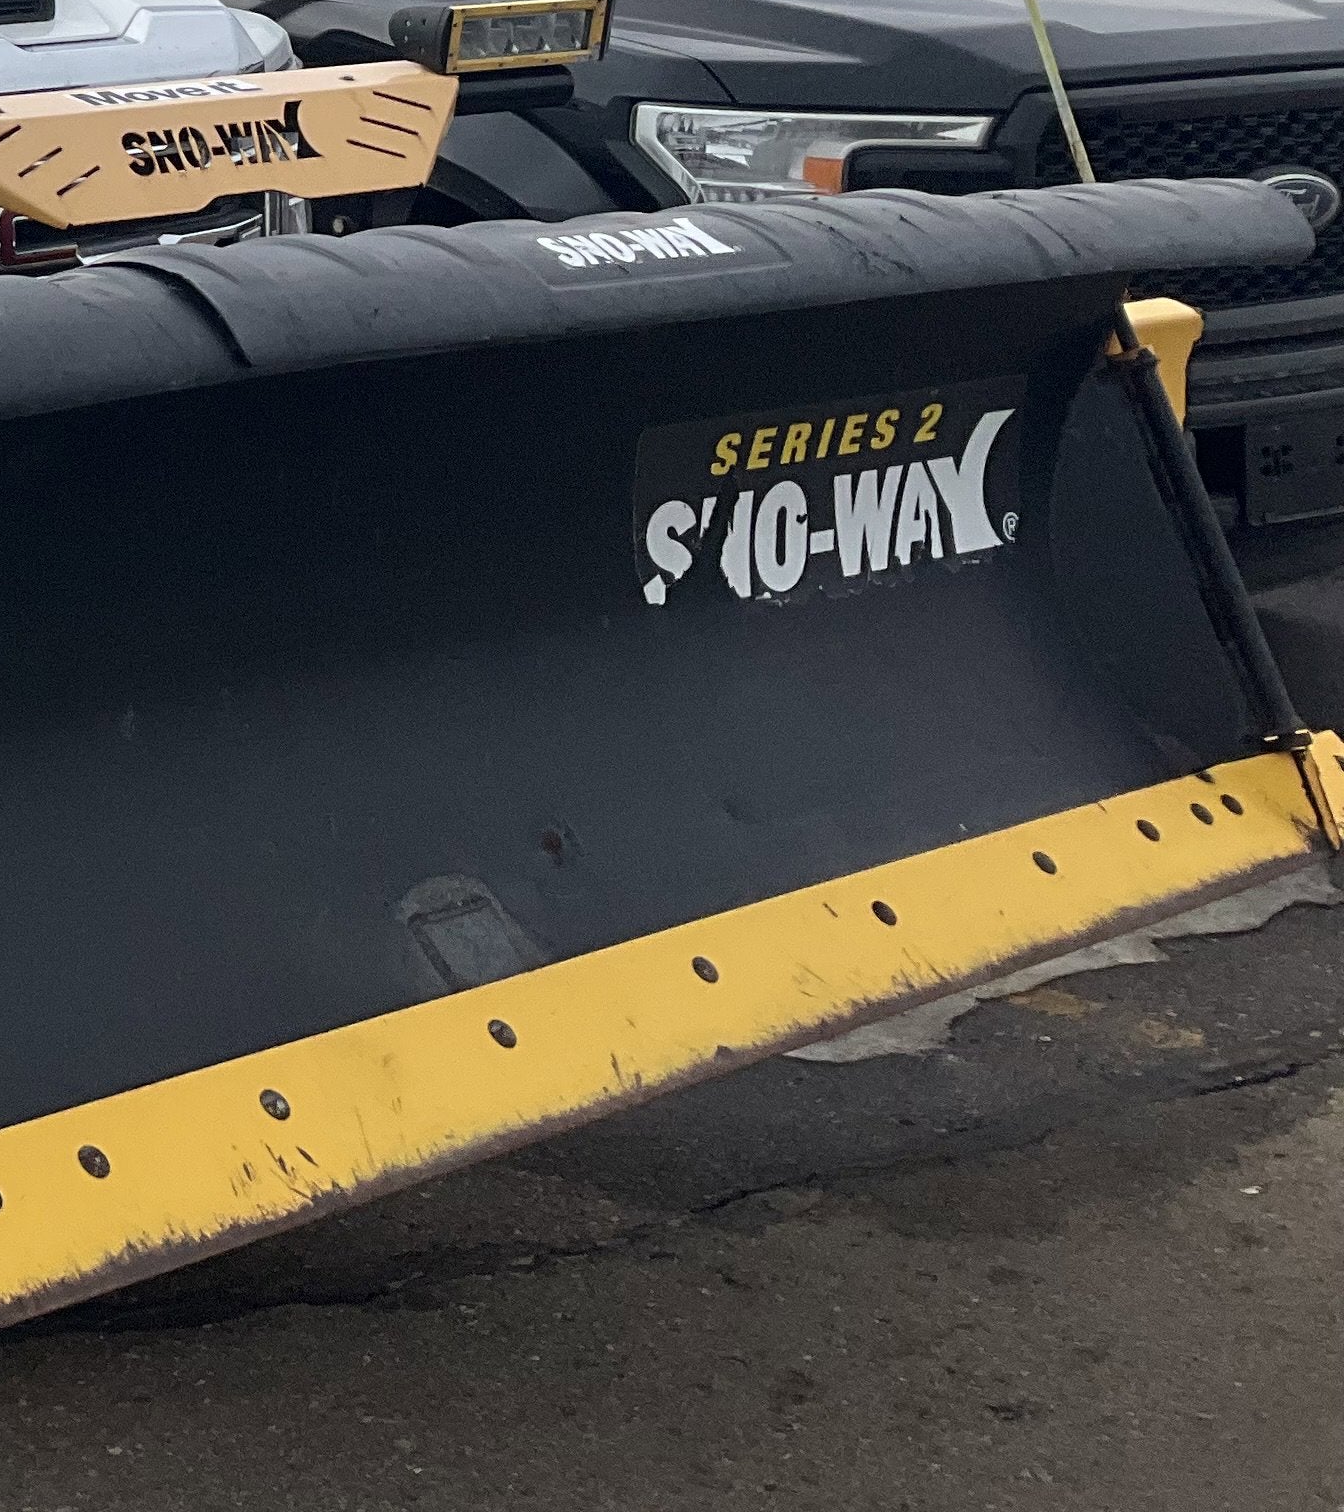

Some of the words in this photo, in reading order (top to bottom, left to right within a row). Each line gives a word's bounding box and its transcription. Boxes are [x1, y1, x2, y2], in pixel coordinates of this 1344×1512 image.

[70, 86, 211, 106] Move
[121, 99, 325, 176] SNO-WAY
[536, 217, 735, 268] SNO-WAY
[710, 409, 900, 476] SERIES
[913, 403, 944, 444] 2
